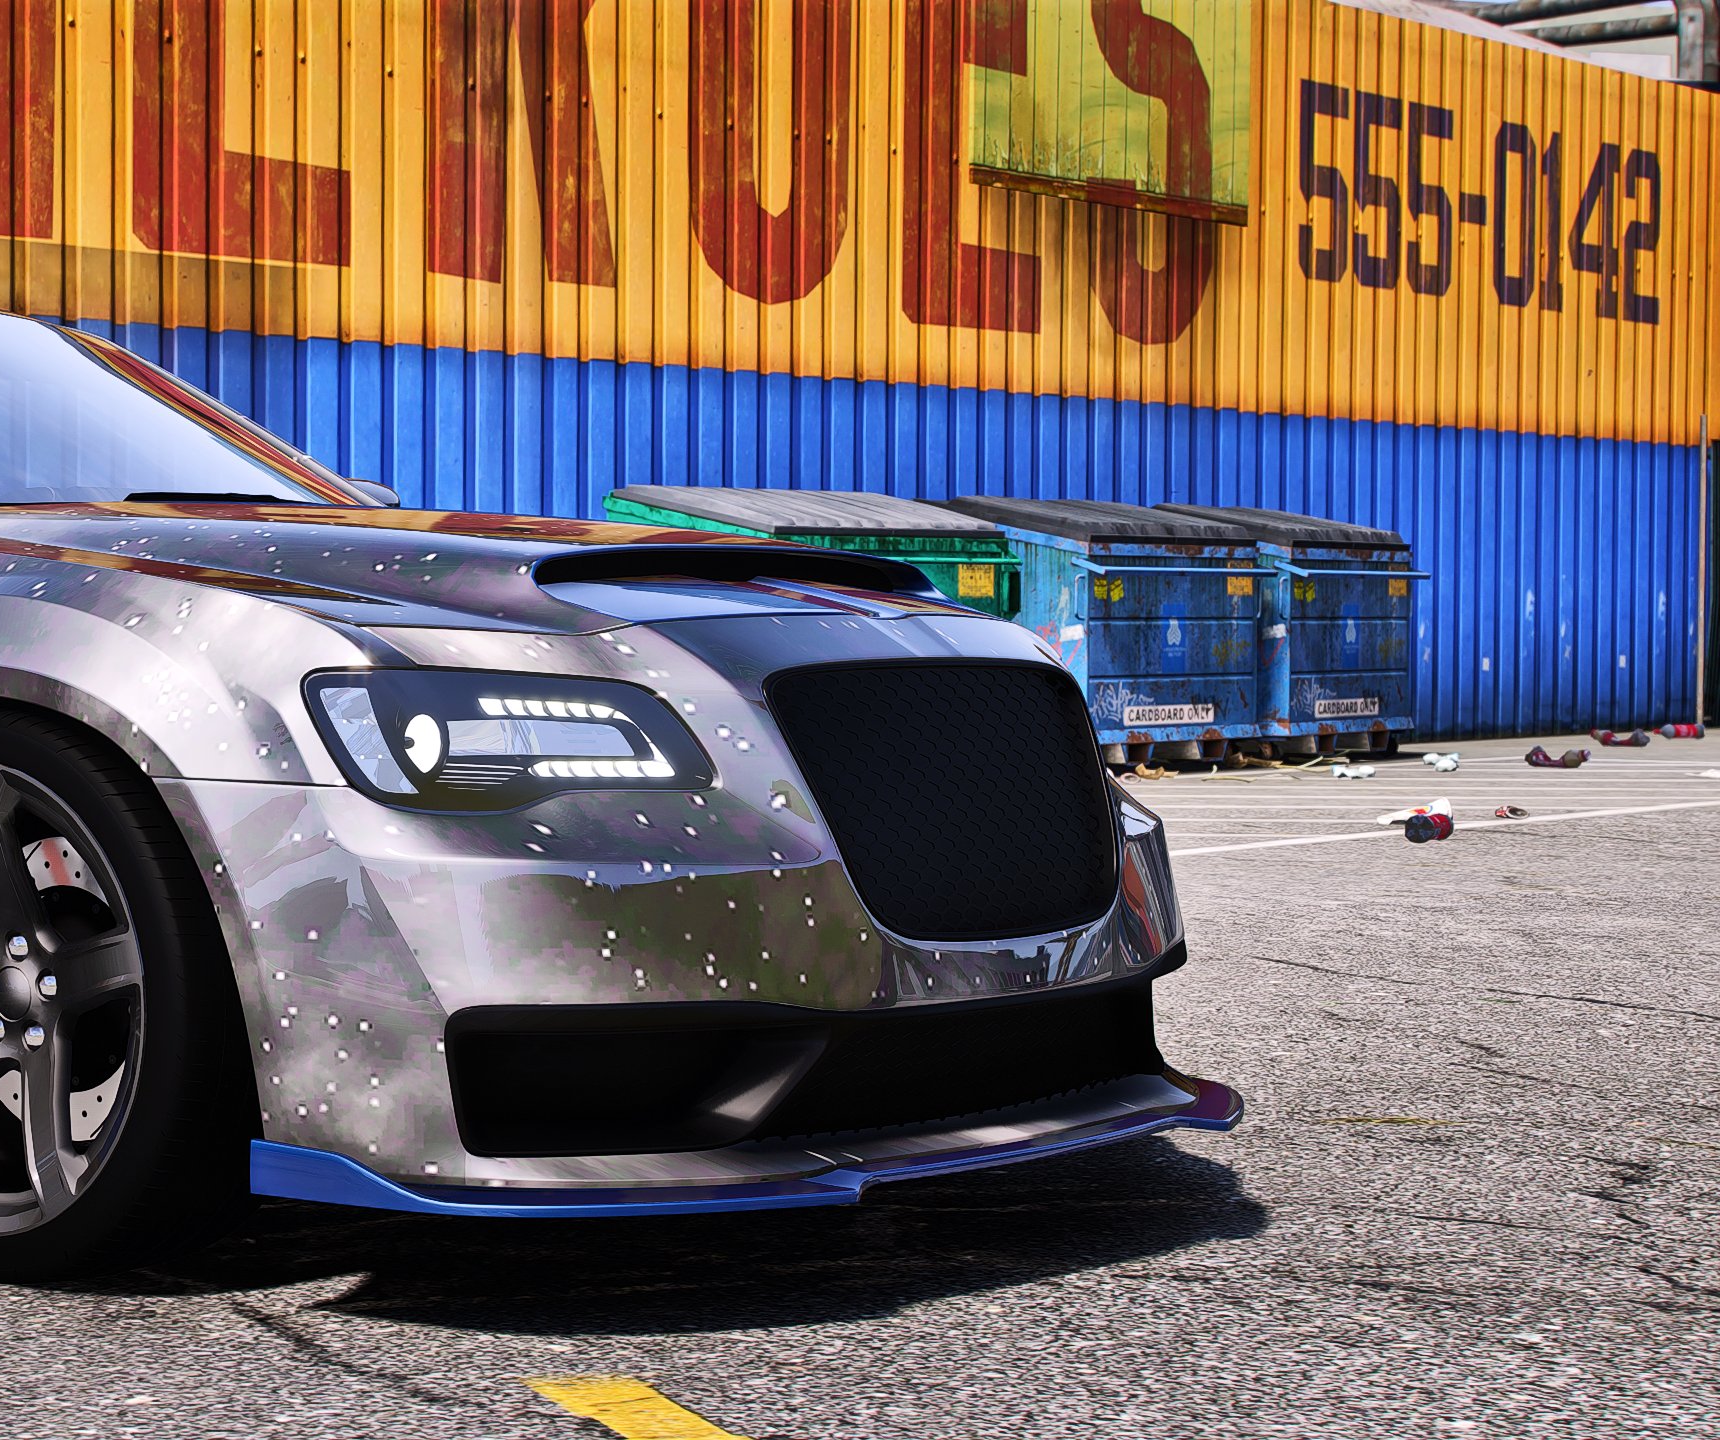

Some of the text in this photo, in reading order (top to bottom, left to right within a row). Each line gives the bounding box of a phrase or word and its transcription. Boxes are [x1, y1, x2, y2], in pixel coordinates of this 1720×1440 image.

[1298, 78, 1662, 326] 555-0142
[1127, 706, 1212, 723] CARDBOARD ONLY
[1317, 700, 1378, 715] CARDBOARD ONLY
